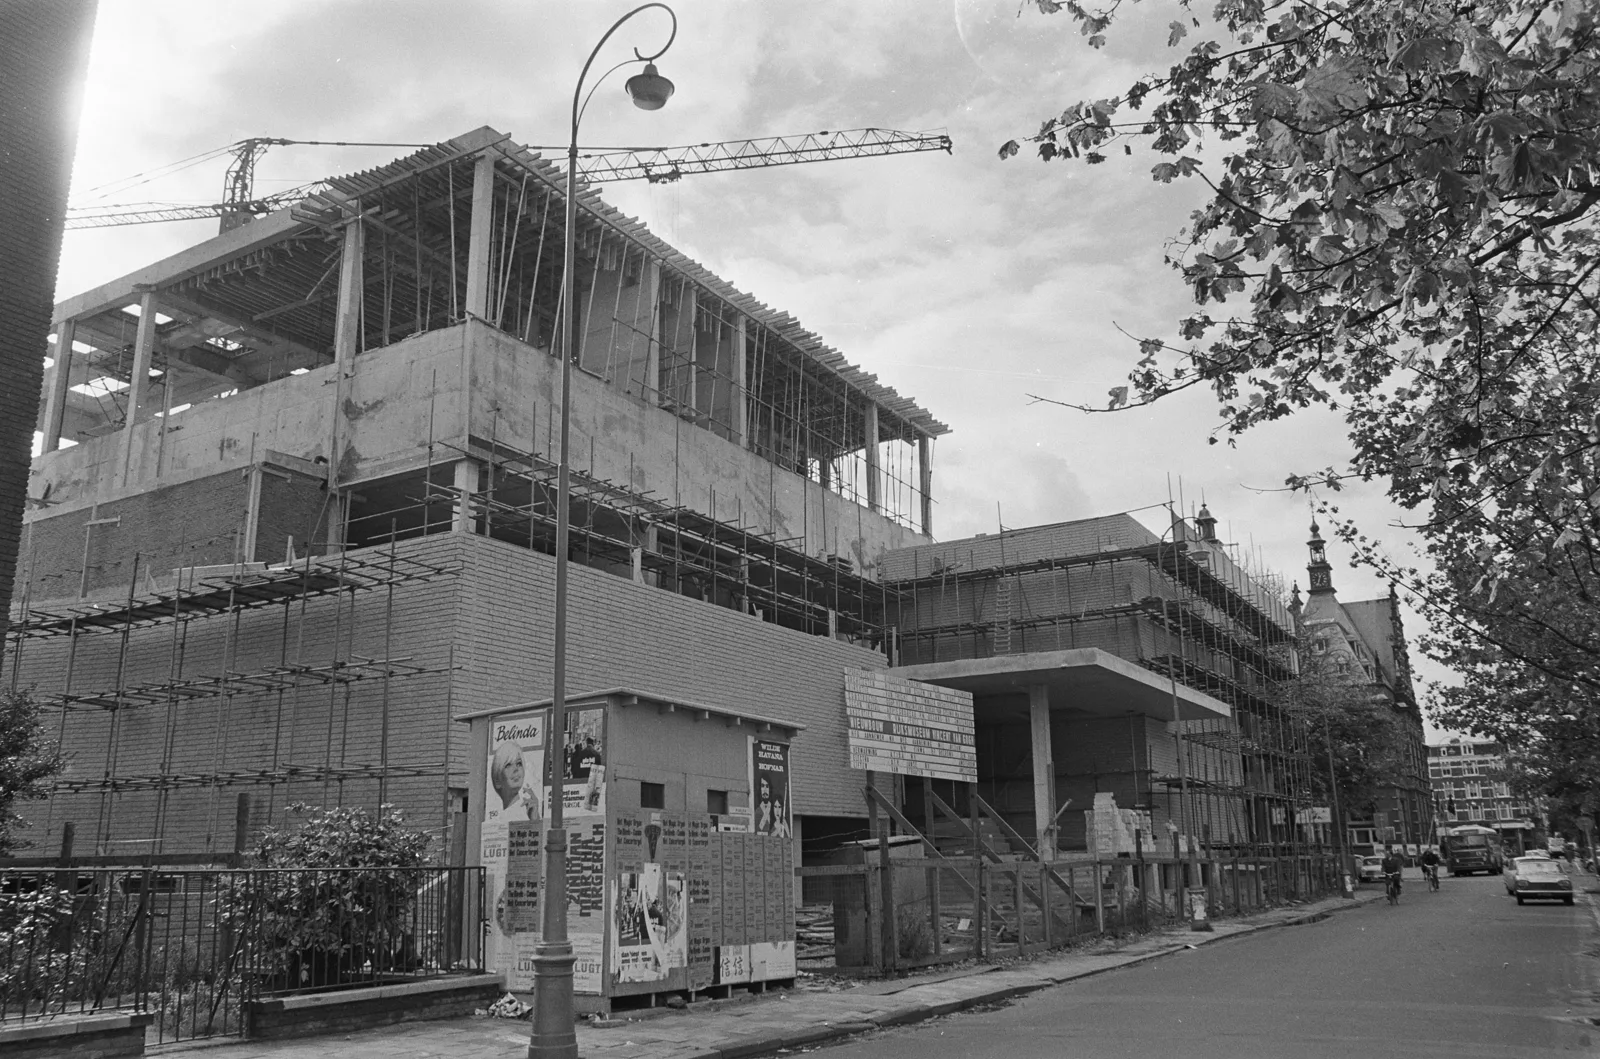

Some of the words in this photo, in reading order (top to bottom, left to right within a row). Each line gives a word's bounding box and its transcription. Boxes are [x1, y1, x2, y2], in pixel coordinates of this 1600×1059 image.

[495, 724, 539, 742] Belinda
[761, 744, 780, 752] WILDE
[758, 751, 784, 760] HAVANA
[758, 763, 784, 772] HOFNAR
[484, 848, 507, 858] LUGT
[568, 833, 581, 904] ZINMAN
[591, 824, 604, 910] ARGERICH
[580, 838, 592, 917] MARTHA
[518, 961, 536, 972] LU
[575, 963, 601, 973] LUGT
